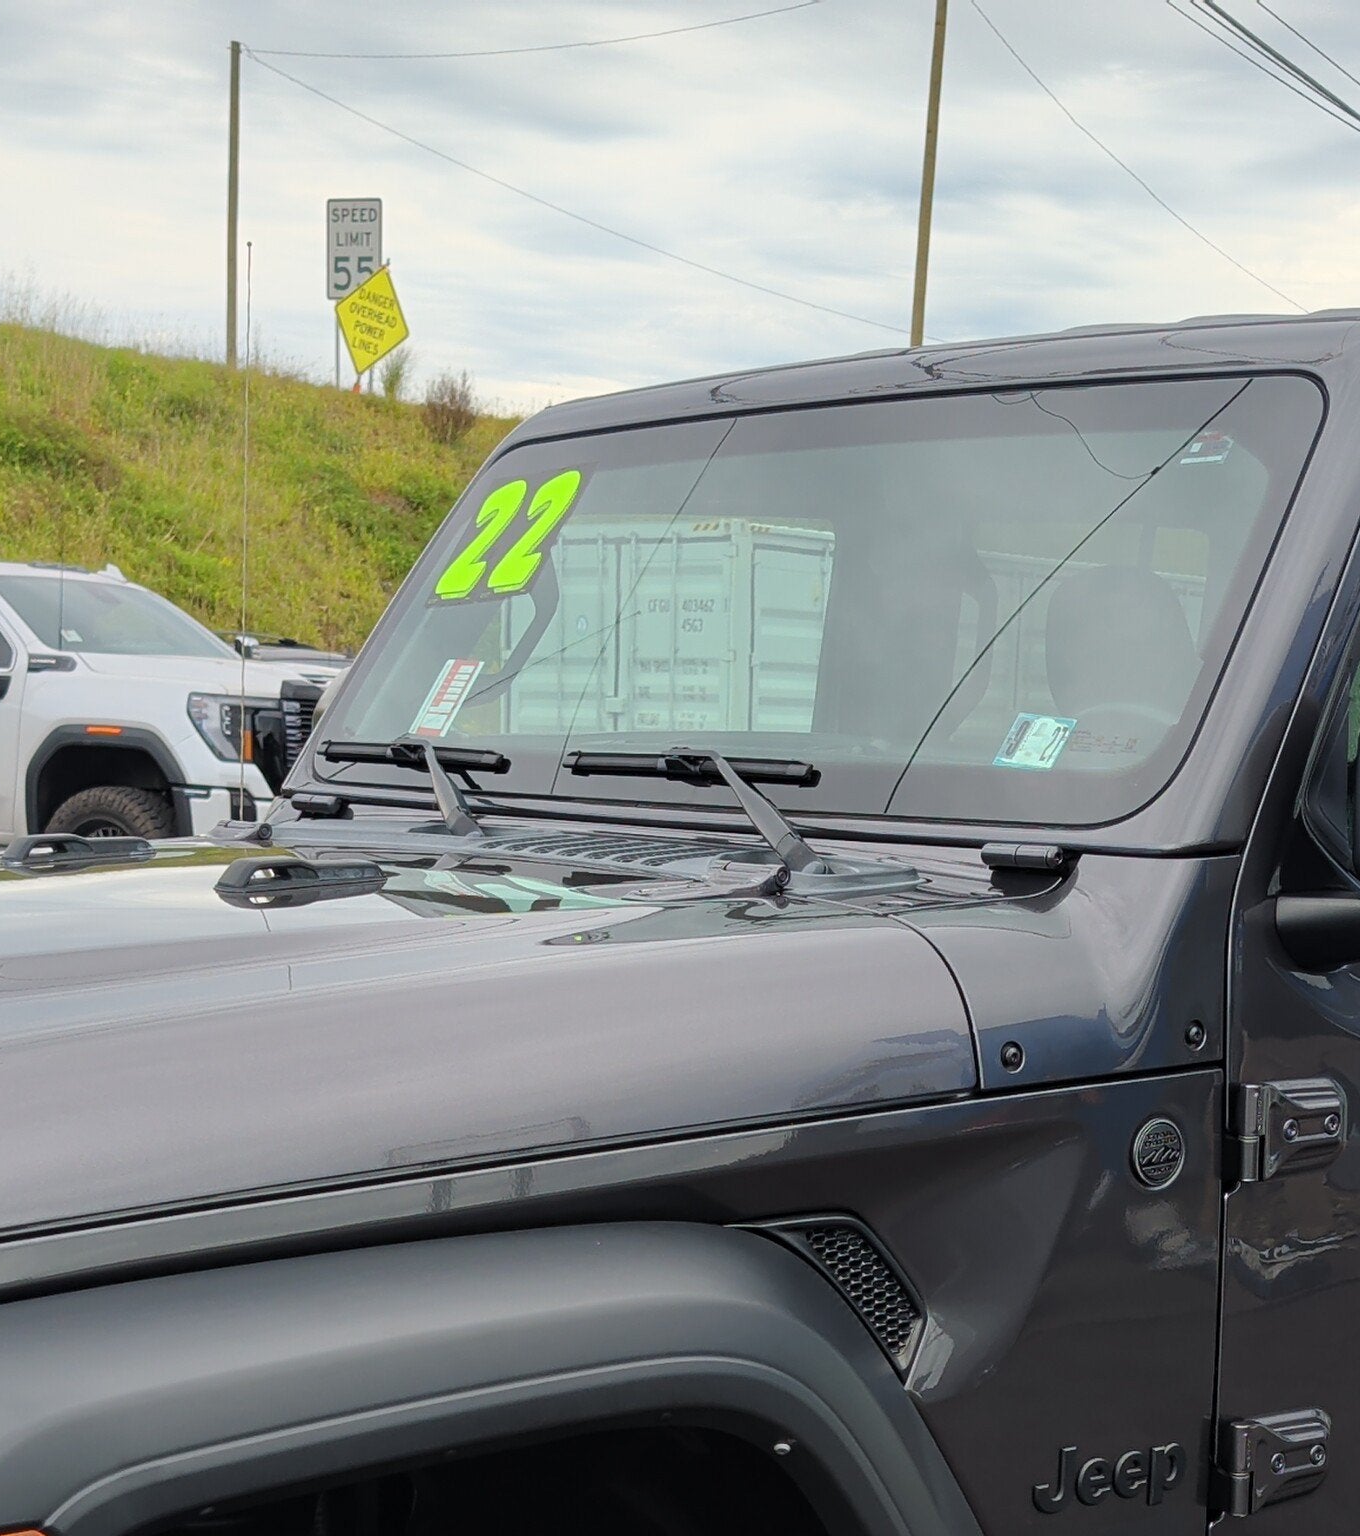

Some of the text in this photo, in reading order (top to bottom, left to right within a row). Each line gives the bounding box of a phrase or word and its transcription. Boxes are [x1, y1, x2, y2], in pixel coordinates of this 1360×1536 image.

[331, 207, 377, 222] SPEED
[336, 232, 372, 247] LIMIT
[358, 288, 396, 311] DANGER
[348, 302, 397, 329] OVERHEAD
[353, 320, 385, 341] POWER
[351, 336, 379, 356] LINES
[435, 470, 581, 600] 22
[1032, 1441, 1187, 1515] Jeep
